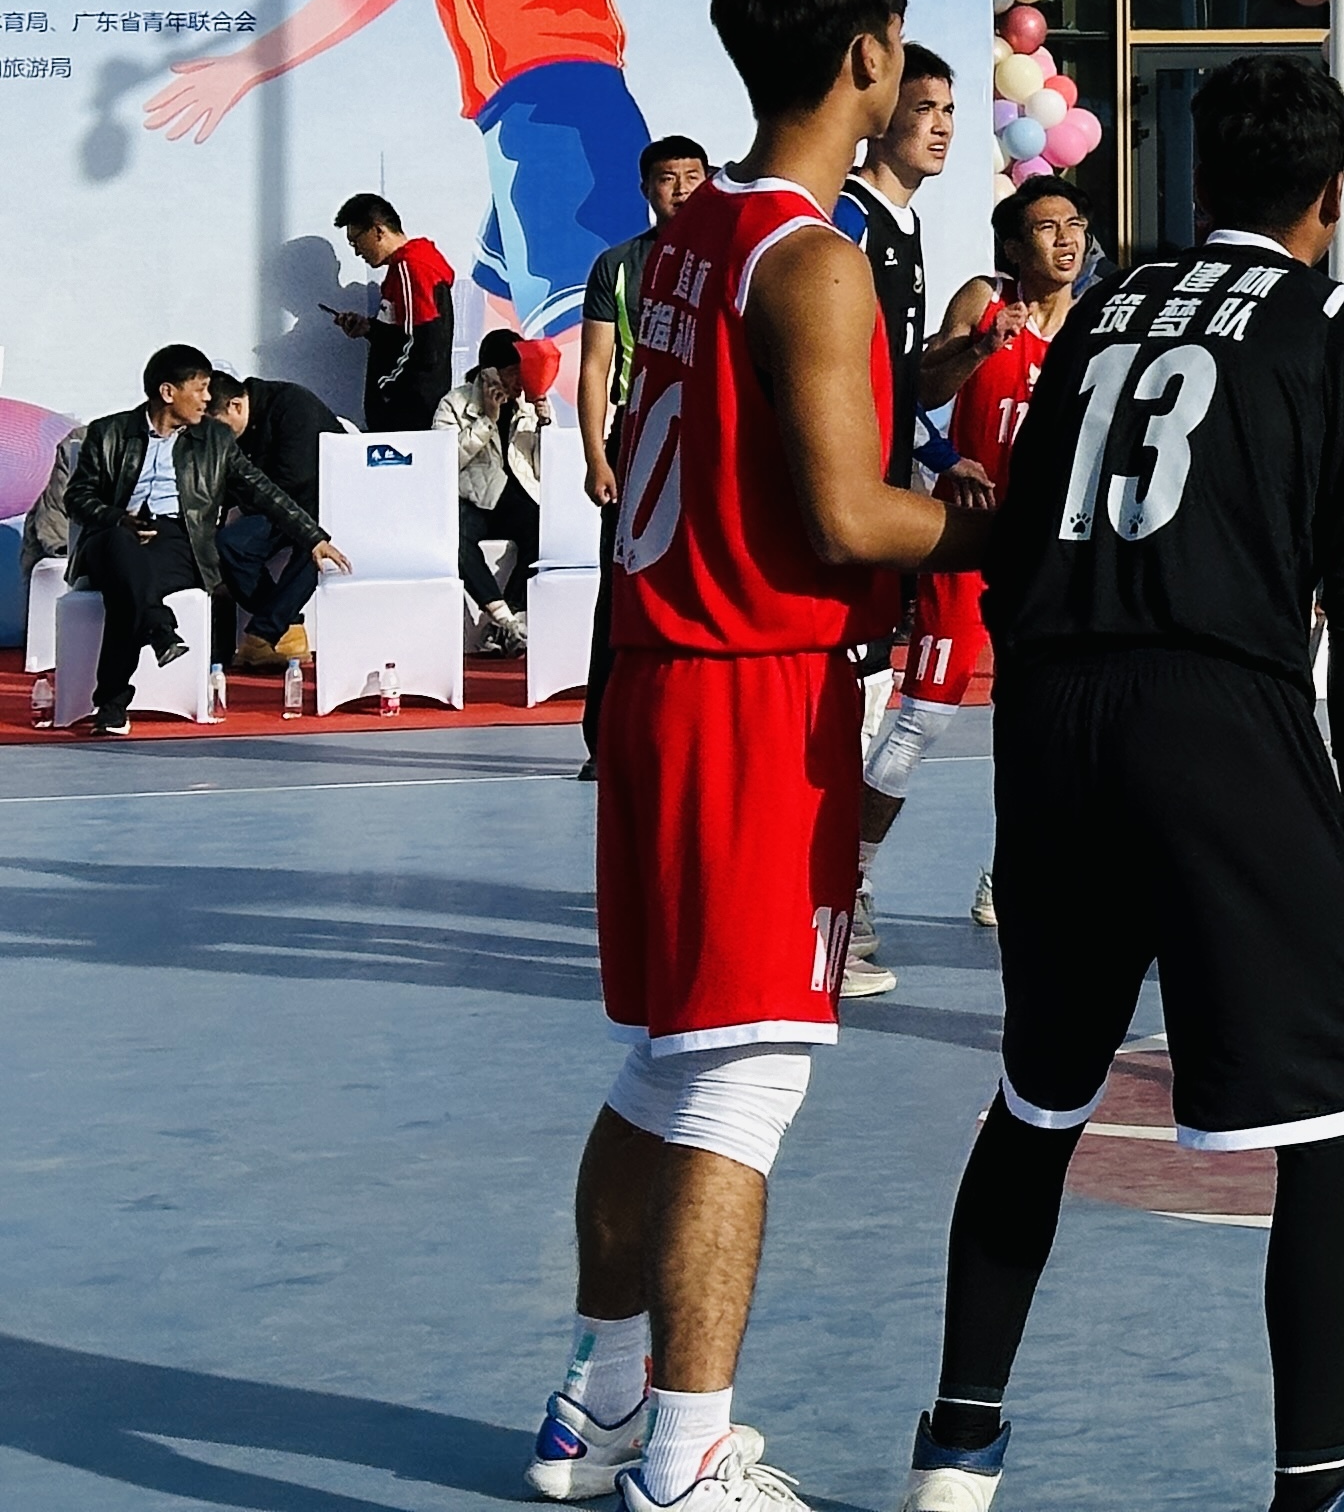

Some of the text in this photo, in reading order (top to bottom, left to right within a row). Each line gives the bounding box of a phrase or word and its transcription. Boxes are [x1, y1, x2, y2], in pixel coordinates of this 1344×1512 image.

[0, 10, 257, 33] 育局、广东省青年联合会
[0, 56, 72, 79] 旅游局
[1119, 261, 1289, 298] 广建杯
[1090, 294, 1257, 341] 筑梦队
[998, 397, 1030, 446] 11
[1058, 343, 1218, 542] 13
[917, 634, 953, 685] 11
[810, 905, 849, 993] 10
